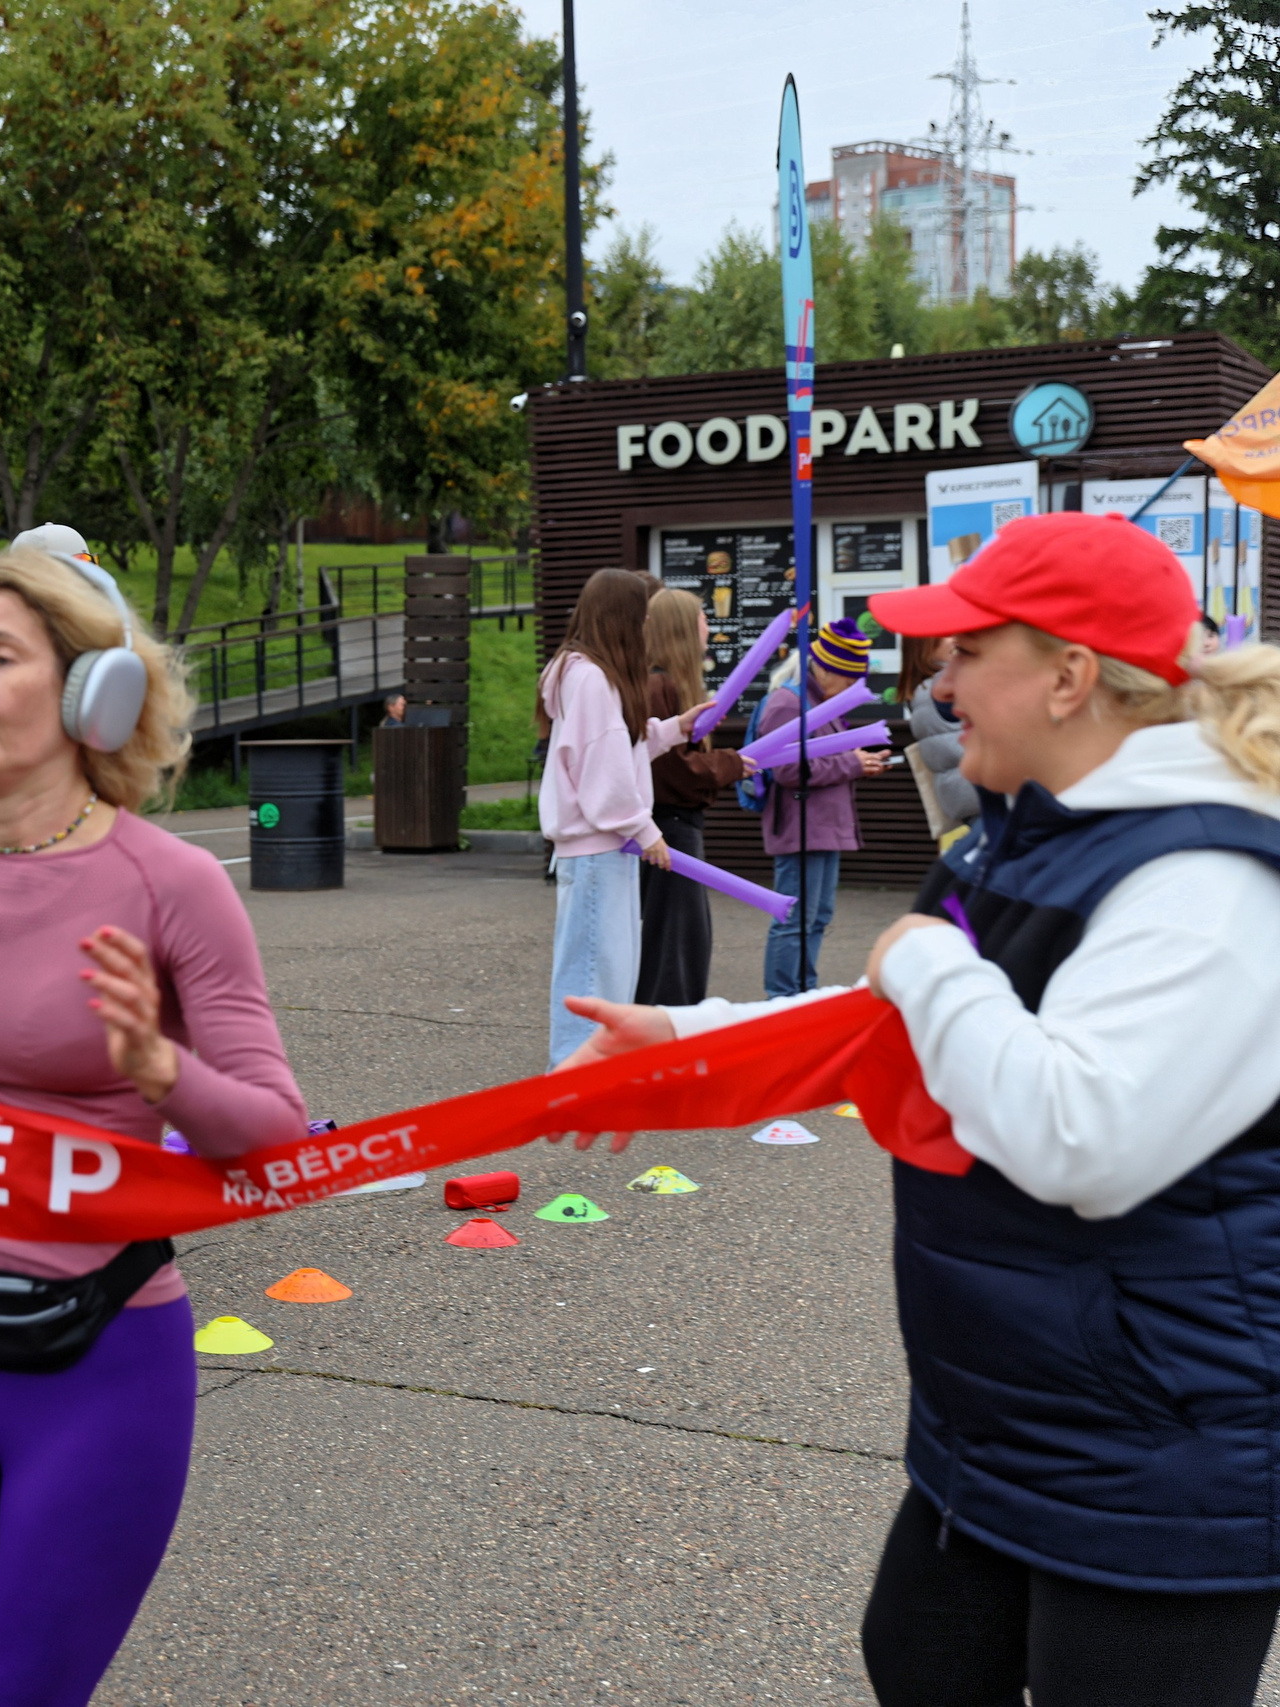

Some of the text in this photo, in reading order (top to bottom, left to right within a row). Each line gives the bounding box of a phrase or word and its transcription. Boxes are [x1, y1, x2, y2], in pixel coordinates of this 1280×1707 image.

[617, 398, 983, 472] FOOD PARK
[263, 1124, 418, 1189] ВЁРСТ
